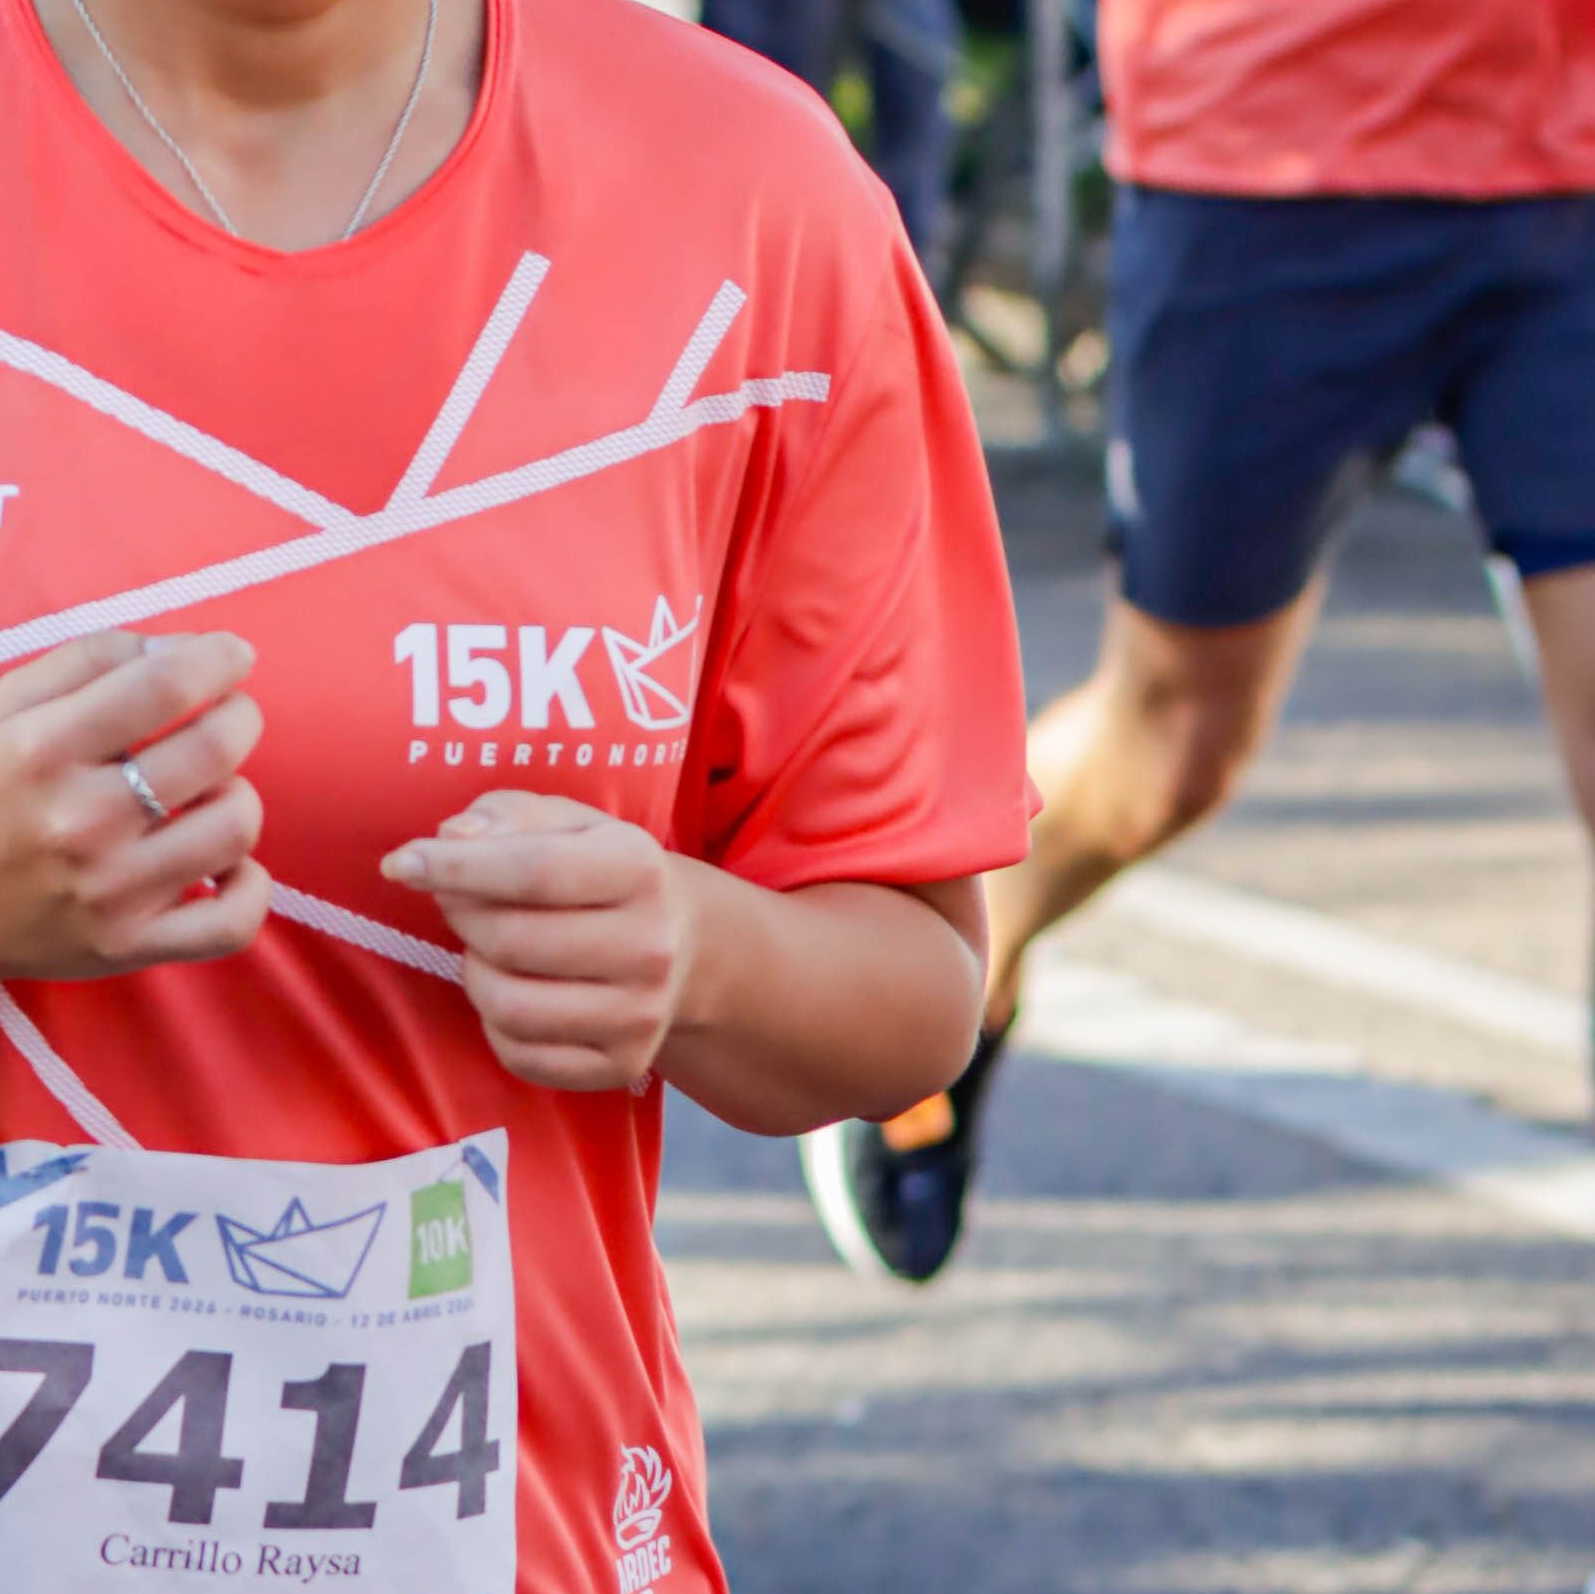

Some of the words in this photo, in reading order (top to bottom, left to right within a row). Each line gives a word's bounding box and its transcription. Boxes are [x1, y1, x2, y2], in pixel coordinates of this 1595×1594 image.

[393, 621, 596, 730] 15K
[408, 740, 594, 767] PUERTO
[31, 1200, 200, 1285] 15K
[417, 1215, 469, 1265] 10K
[17, 1288, 91, 1305] PUERTO
[97, 1290, 162, 1310] NORTE
[239, 1304, 327, 1328] ROSARIO
[351, 1313, 370, 1328] 12
[376, 1311, 396, 1327] DE
[99, 1532, 243, 1575] Carrillo
[257, 1543, 361, 1584] Raysa
